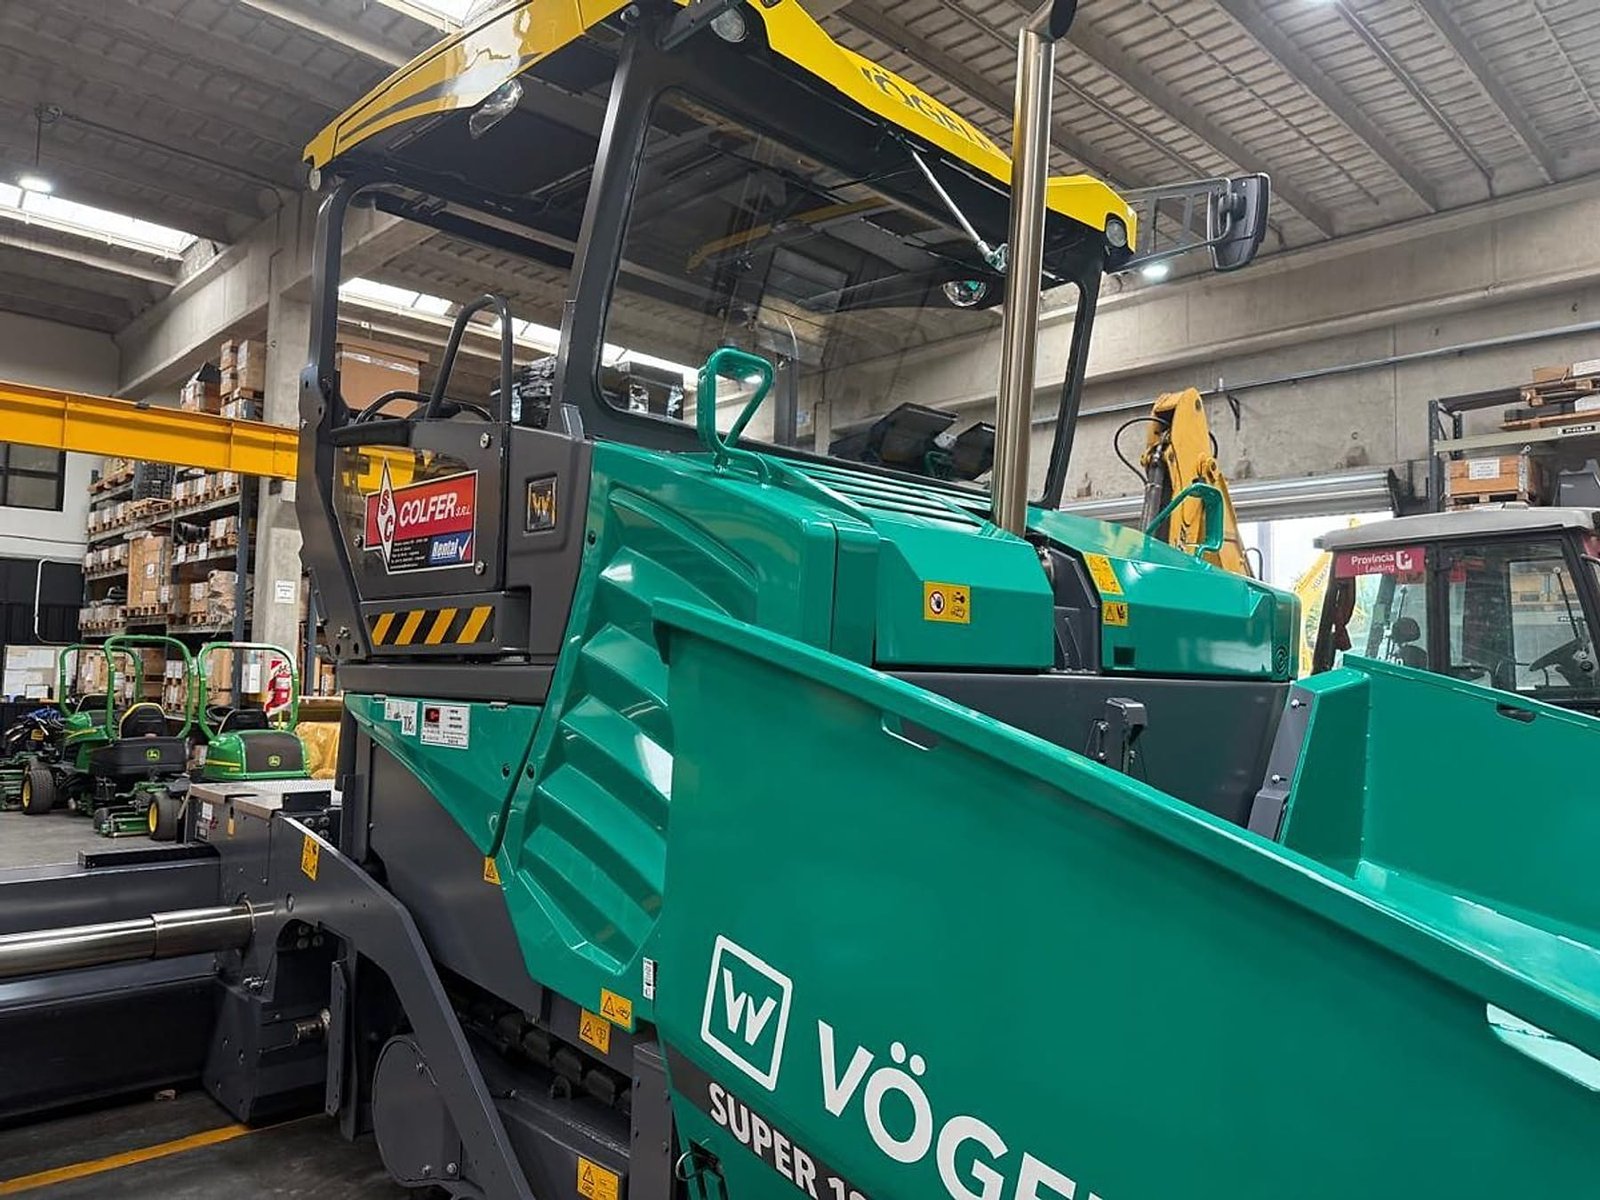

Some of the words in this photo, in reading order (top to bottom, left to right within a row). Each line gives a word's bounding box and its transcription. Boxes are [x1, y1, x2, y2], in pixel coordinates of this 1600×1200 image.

[399, 492, 458, 528] COLFER
[431, 538, 460, 558] Rental
[1350, 552, 1394, 565] Provincia
[817, 1019, 1110, 1200] VÖG
[708, 1081, 818, 1200] SUPER
